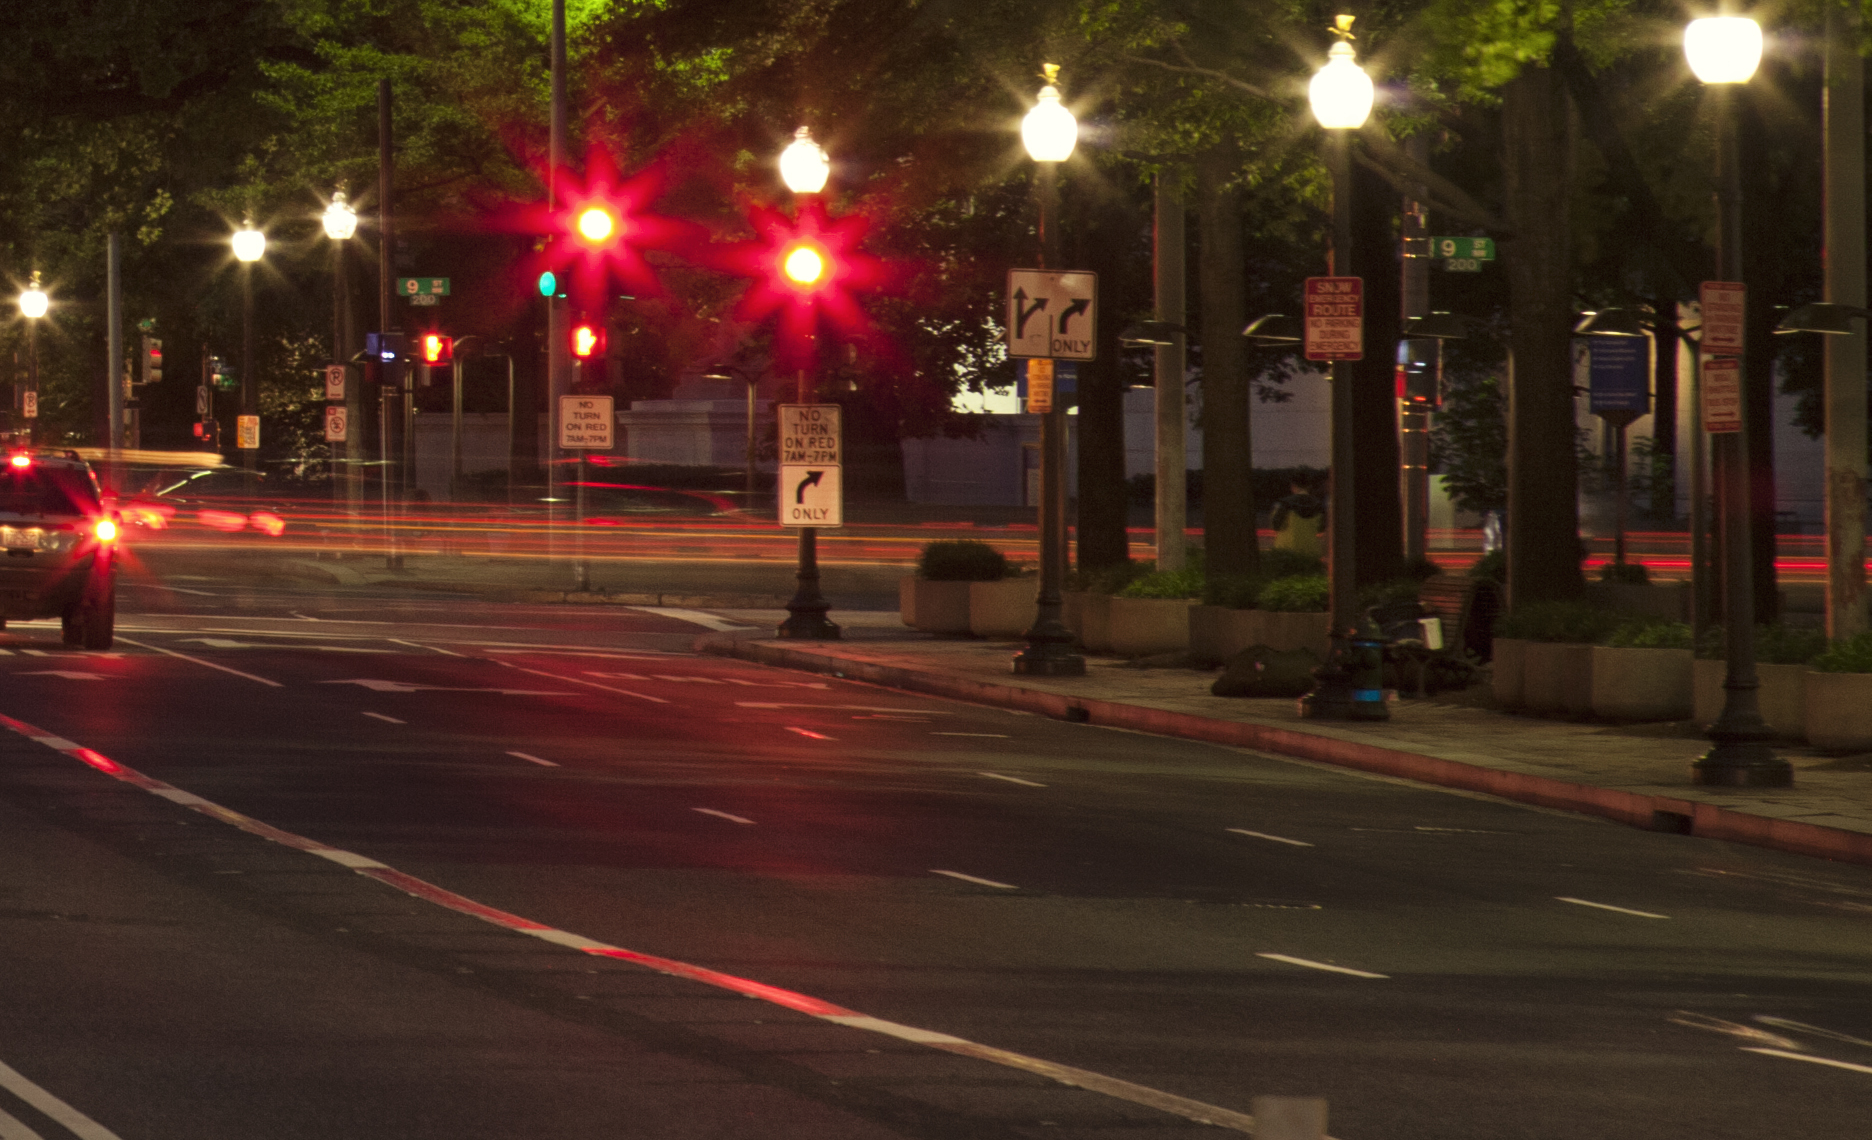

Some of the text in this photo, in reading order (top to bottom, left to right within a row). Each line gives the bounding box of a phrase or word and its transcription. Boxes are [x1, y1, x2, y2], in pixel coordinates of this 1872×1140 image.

[1441, 240, 1455, 256] 9
[407, 280, 418, 294] 9
[1317, 282, 1353, 293] SNOW
[1313, 304, 1356, 315] ROUTE
[1053, 339, 1090, 353] ONLY
[579, 401, 594, 409] NO
[573, 412, 601, 420] TURN
[799, 410, 821, 421] NO
[566, 423, 608, 431] ON RED
[793, 424, 828, 435] TURN
[785, 438, 836, 449] ON RED
[784, 451, 837, 461] 7AM-7PM
[793, 508, 829, 520] ONLY
